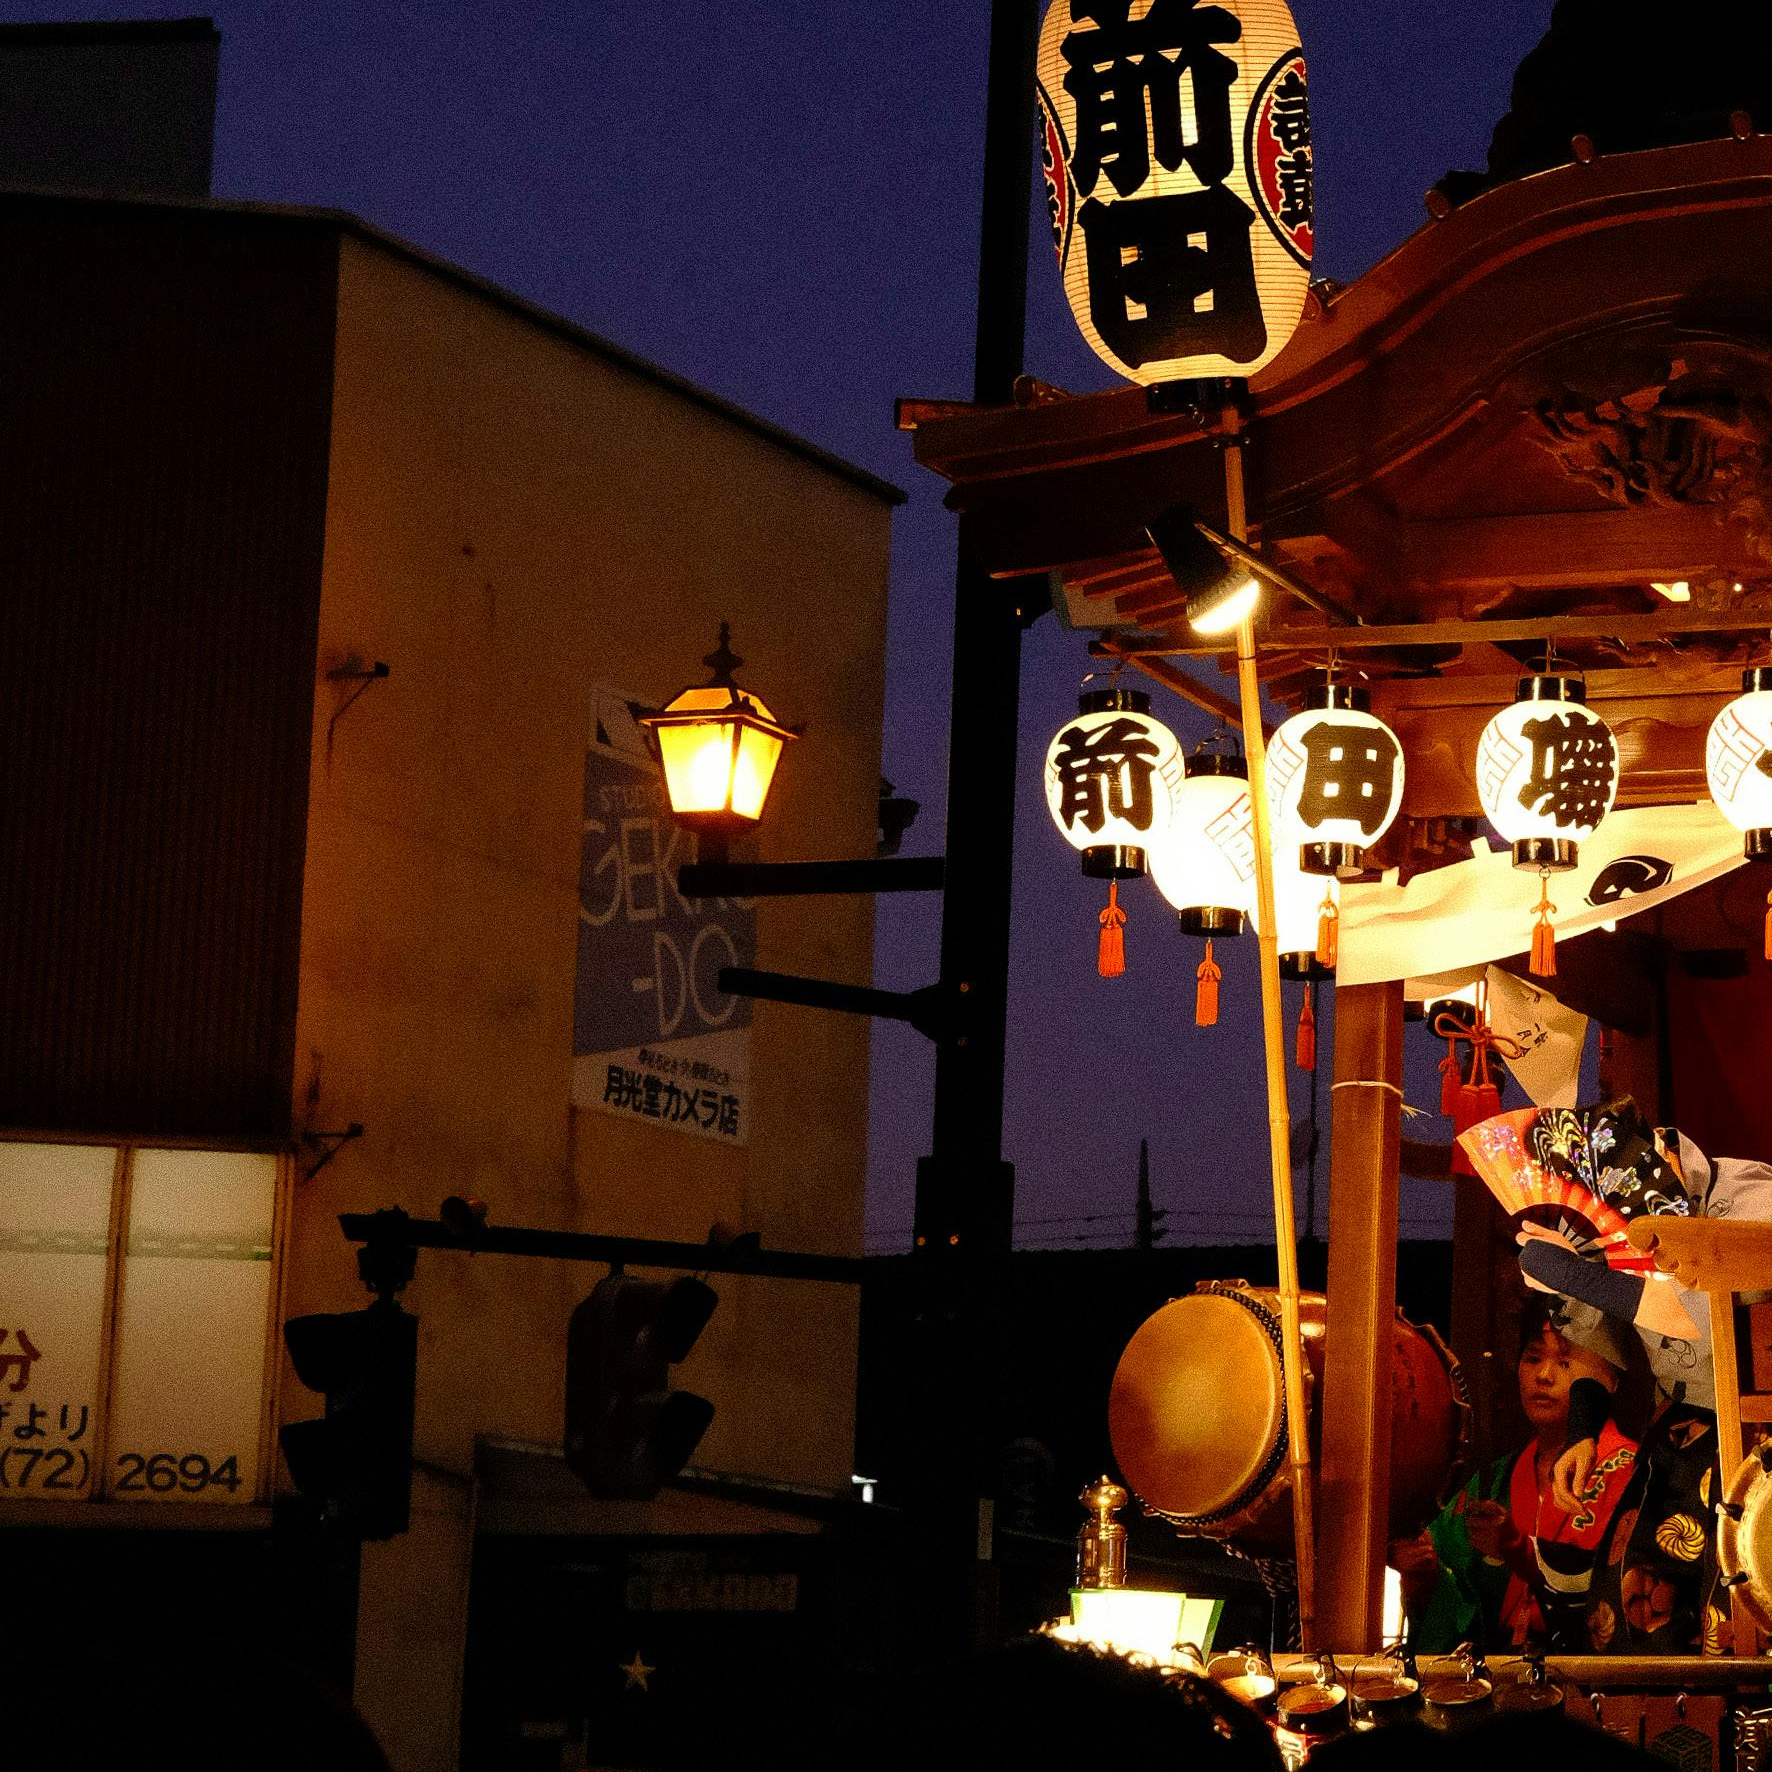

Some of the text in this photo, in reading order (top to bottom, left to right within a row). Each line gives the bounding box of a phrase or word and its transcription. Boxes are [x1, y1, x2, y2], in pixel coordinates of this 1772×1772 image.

[1056, 717, 1161, 833] 前
[1296, 721, 1399, 836] 田
[580, 818, 756, 926] GEK
[604, 1065, 739, 1136] 月光堂カメラ店
[1, 1447, 242, 1493] (72) 2694
